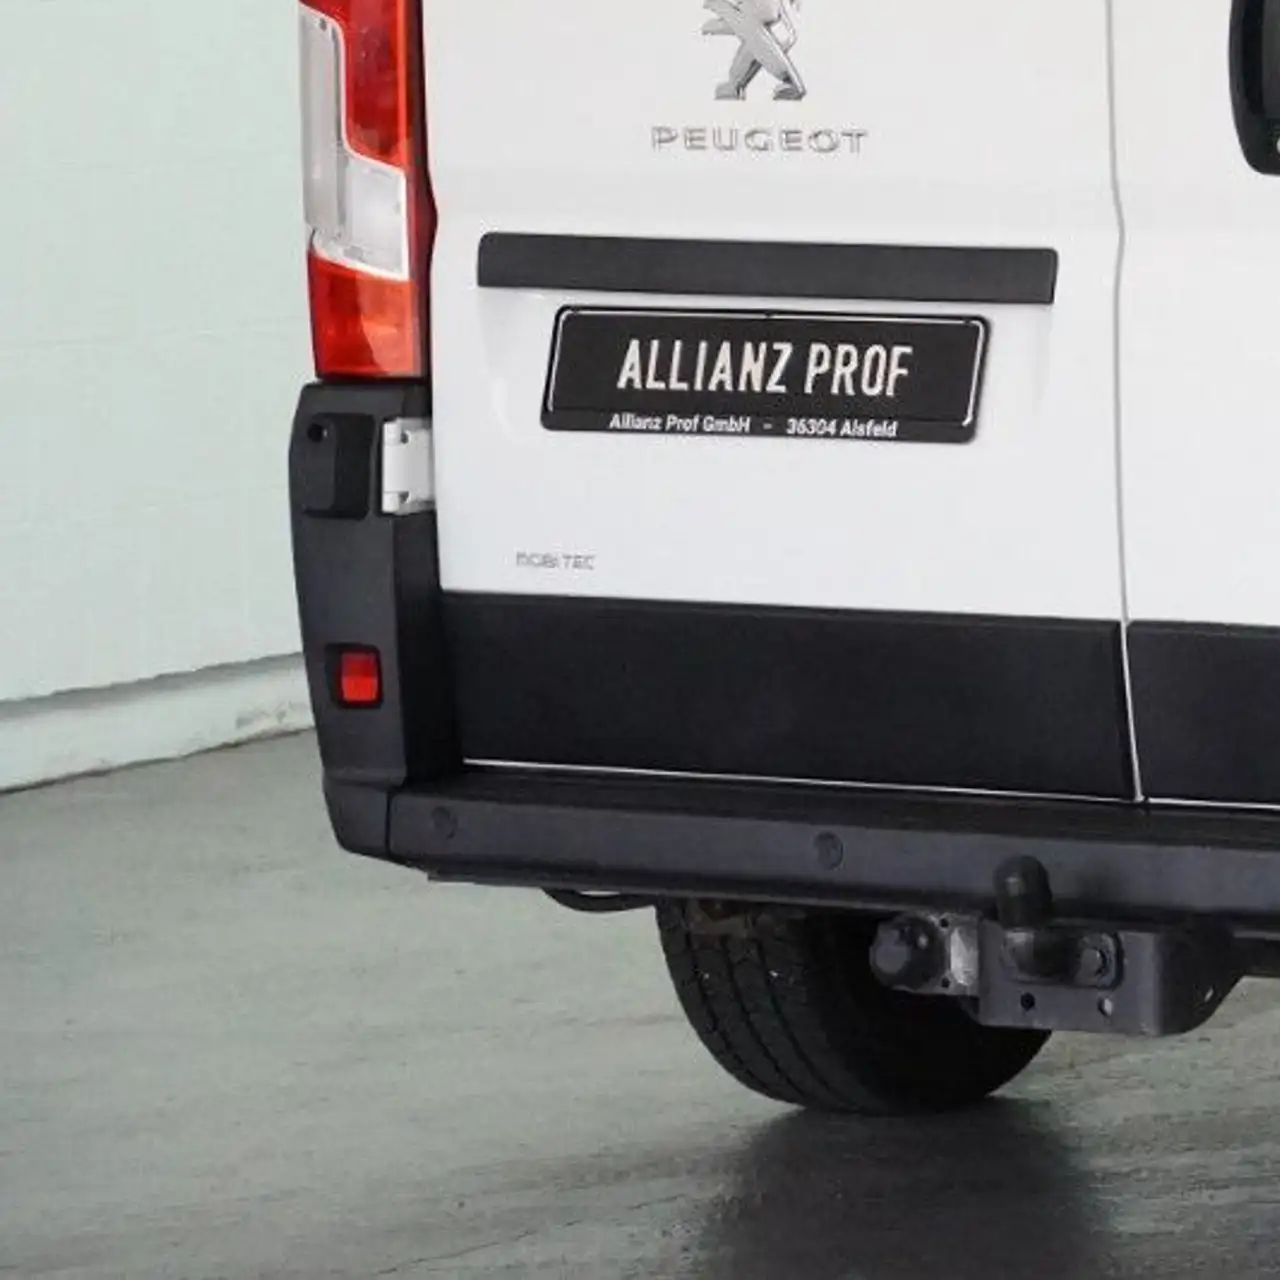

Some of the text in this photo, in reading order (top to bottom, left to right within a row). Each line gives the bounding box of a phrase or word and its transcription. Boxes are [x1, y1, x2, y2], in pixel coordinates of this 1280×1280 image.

[650, 125, 868, 154] PEUGEOT
[616, 338, 913, 397] ALLIANZ PROF
[609, 412, 663, 430] Allianz
[665, 413, 700, 432] Prof
[703, 415, 751, 433] GmbH
[786, 417, 837, 436] 36304
[840, 418, 899, 438] Alsfeld
